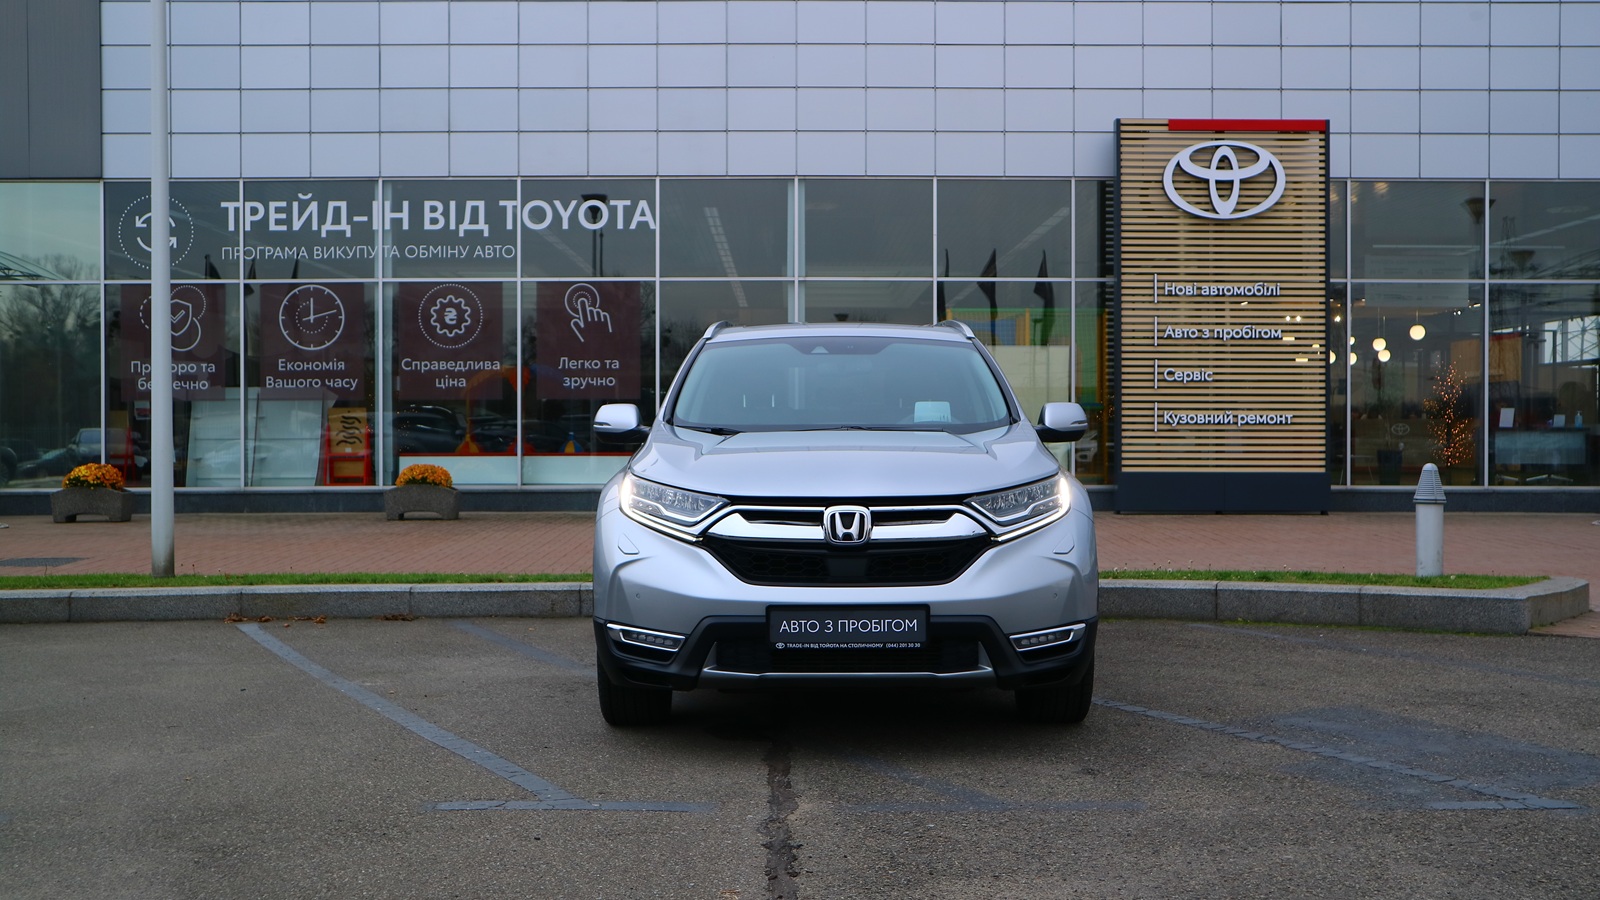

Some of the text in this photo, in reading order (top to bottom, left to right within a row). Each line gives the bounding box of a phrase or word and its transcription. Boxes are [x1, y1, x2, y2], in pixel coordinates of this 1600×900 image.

[220, 193, 656, 237] ТРЕЙД-ІН ВІД TOYOTA
[221, 245, 516, 260] ПРОГРАМА ВИКУПУ ТА ОБМІНУ АВТО
[1164, 282, 1281, 296] Нові автомобілі
[1164, 325, 1282, 341] Авто з пробігом
[130, 361, 216, 376] Проро та
[278, 358, 345, 371] Економія
[401, 358, 500, 373] Справедлива
[558, 357, 620, 369] Легко та
[138, 376, 209, 390] бечно
[265, 376, 358, 391] Вашого часу
[435, 375, 467, 388] ціна
[563, 377, 616, 389] зручно
[1164, 368, 1213, 384] Сервіс
[1163, 411, 1293, 427] Кузовний ремонт
[779, 620, 820, 633] АВТО
[838, 619, 918, 633] ПРОБІГОМ
